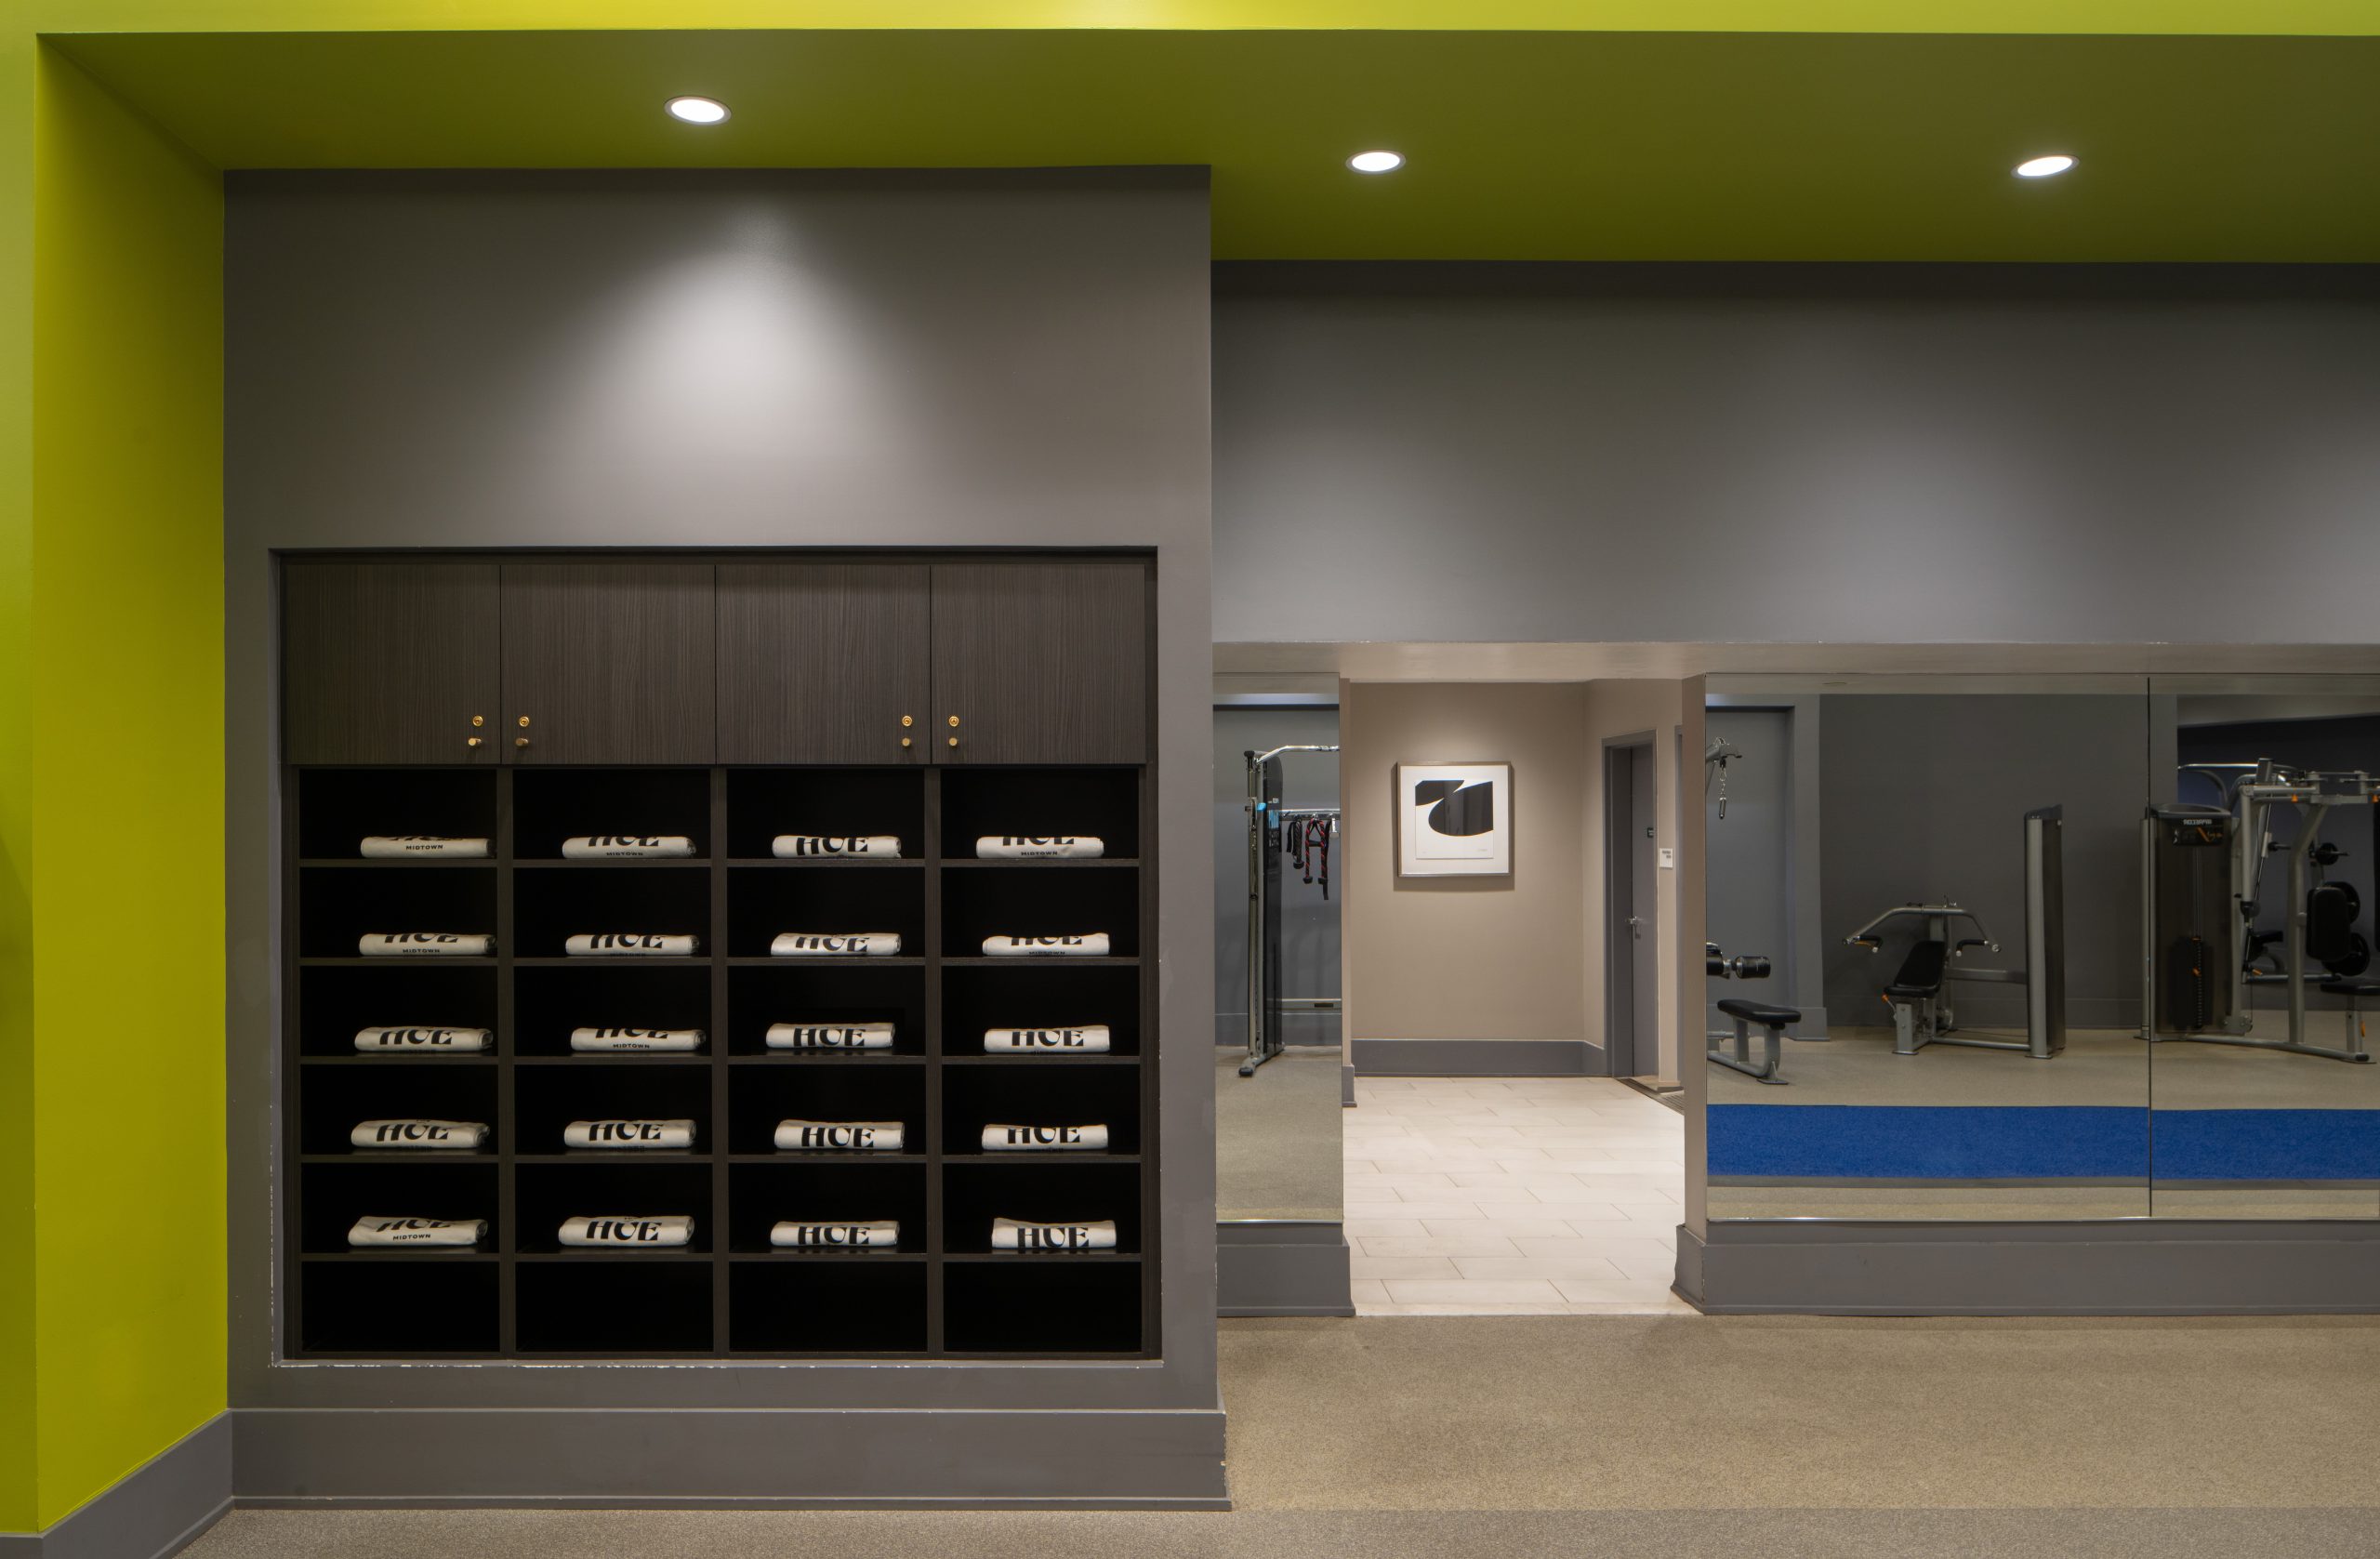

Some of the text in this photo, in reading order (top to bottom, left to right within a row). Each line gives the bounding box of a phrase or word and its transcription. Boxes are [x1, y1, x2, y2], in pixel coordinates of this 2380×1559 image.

[793, 1028, 866, 1047] HUE
[801, 1127, 875, 1147] HUE
[586, 1221, 662, 1241] HUE
[798, 1226, 870, 1244] HUE
[1017, 1227, 1090, 1248] HUE
